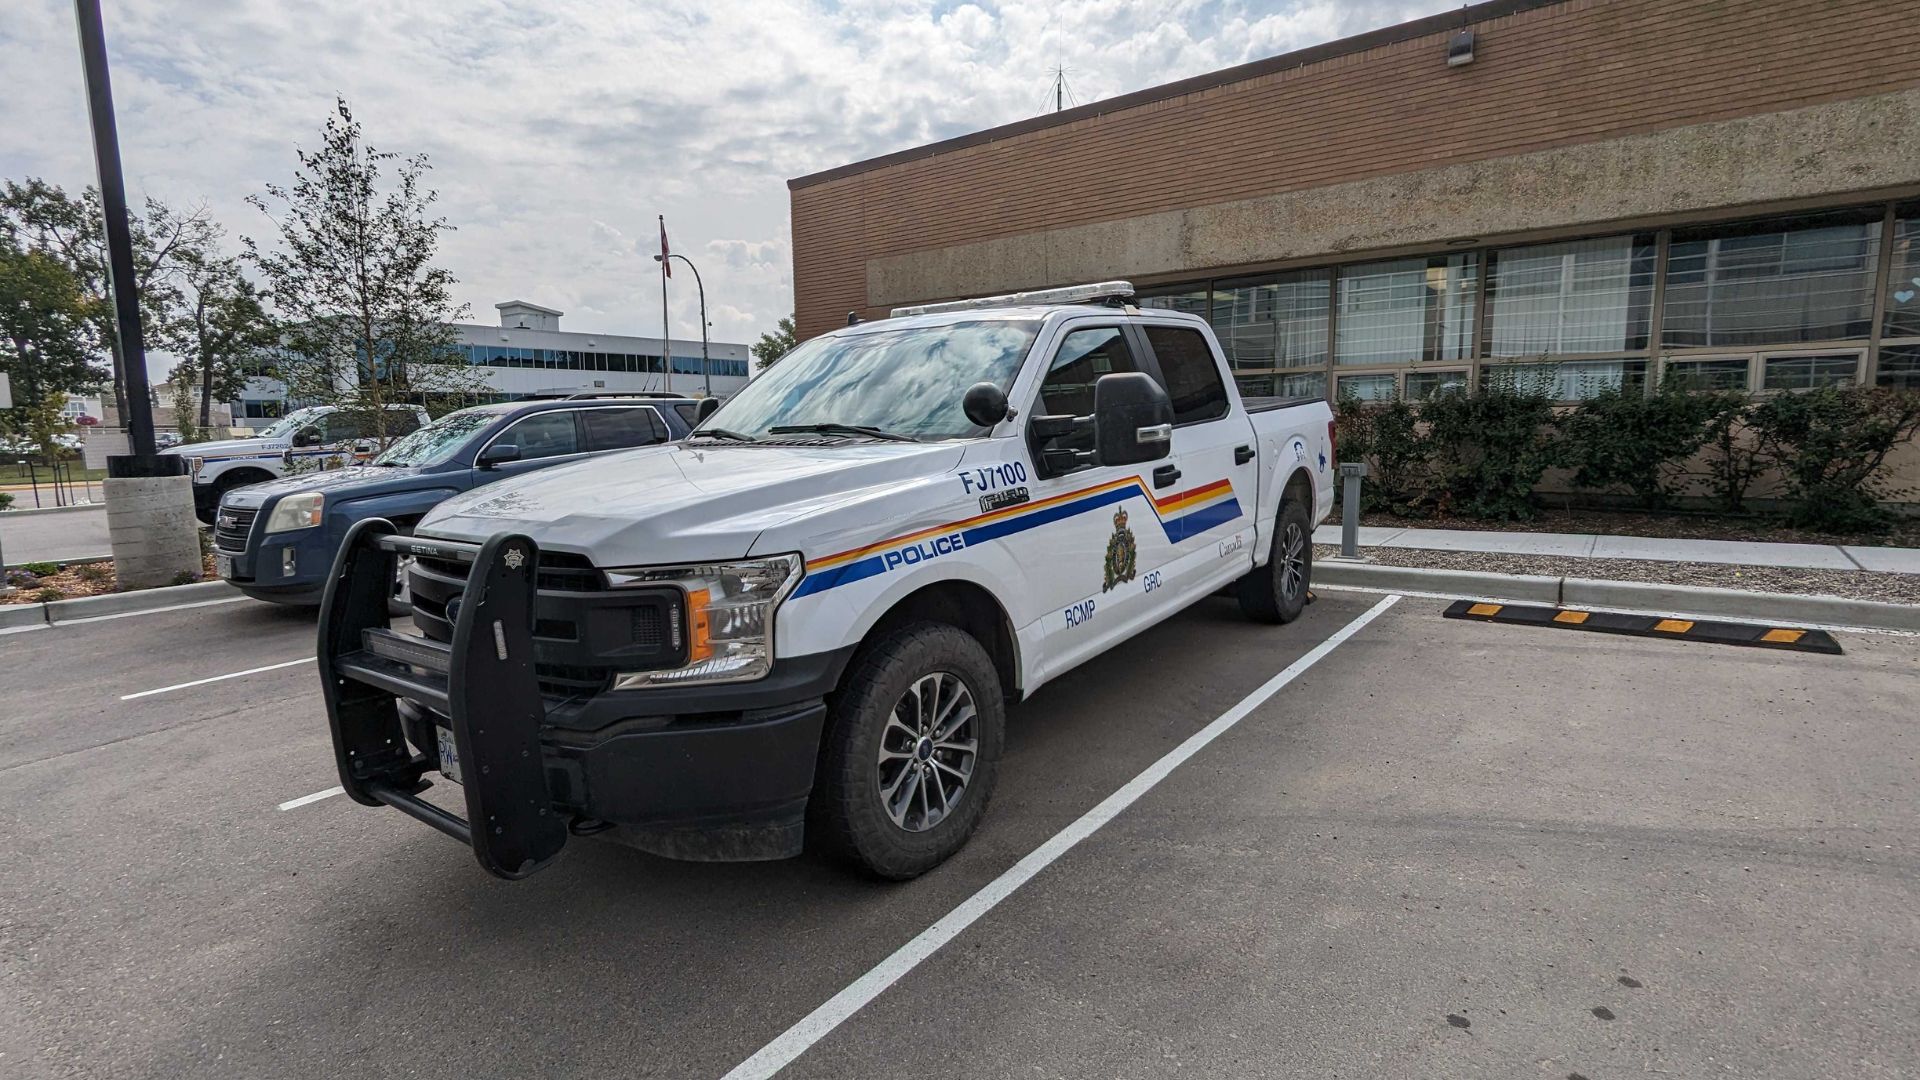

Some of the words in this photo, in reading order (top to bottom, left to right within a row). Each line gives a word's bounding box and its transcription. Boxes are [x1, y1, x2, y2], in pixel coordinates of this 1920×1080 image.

[958, 461, 1027, 494] FJ7100
[410, 545, 439, 556] SETINA
[884, 533, 964, 571] POLICE
[1143, 570, 1162, 594] GRC
[1064, 599, 1096, 630] RCMP
